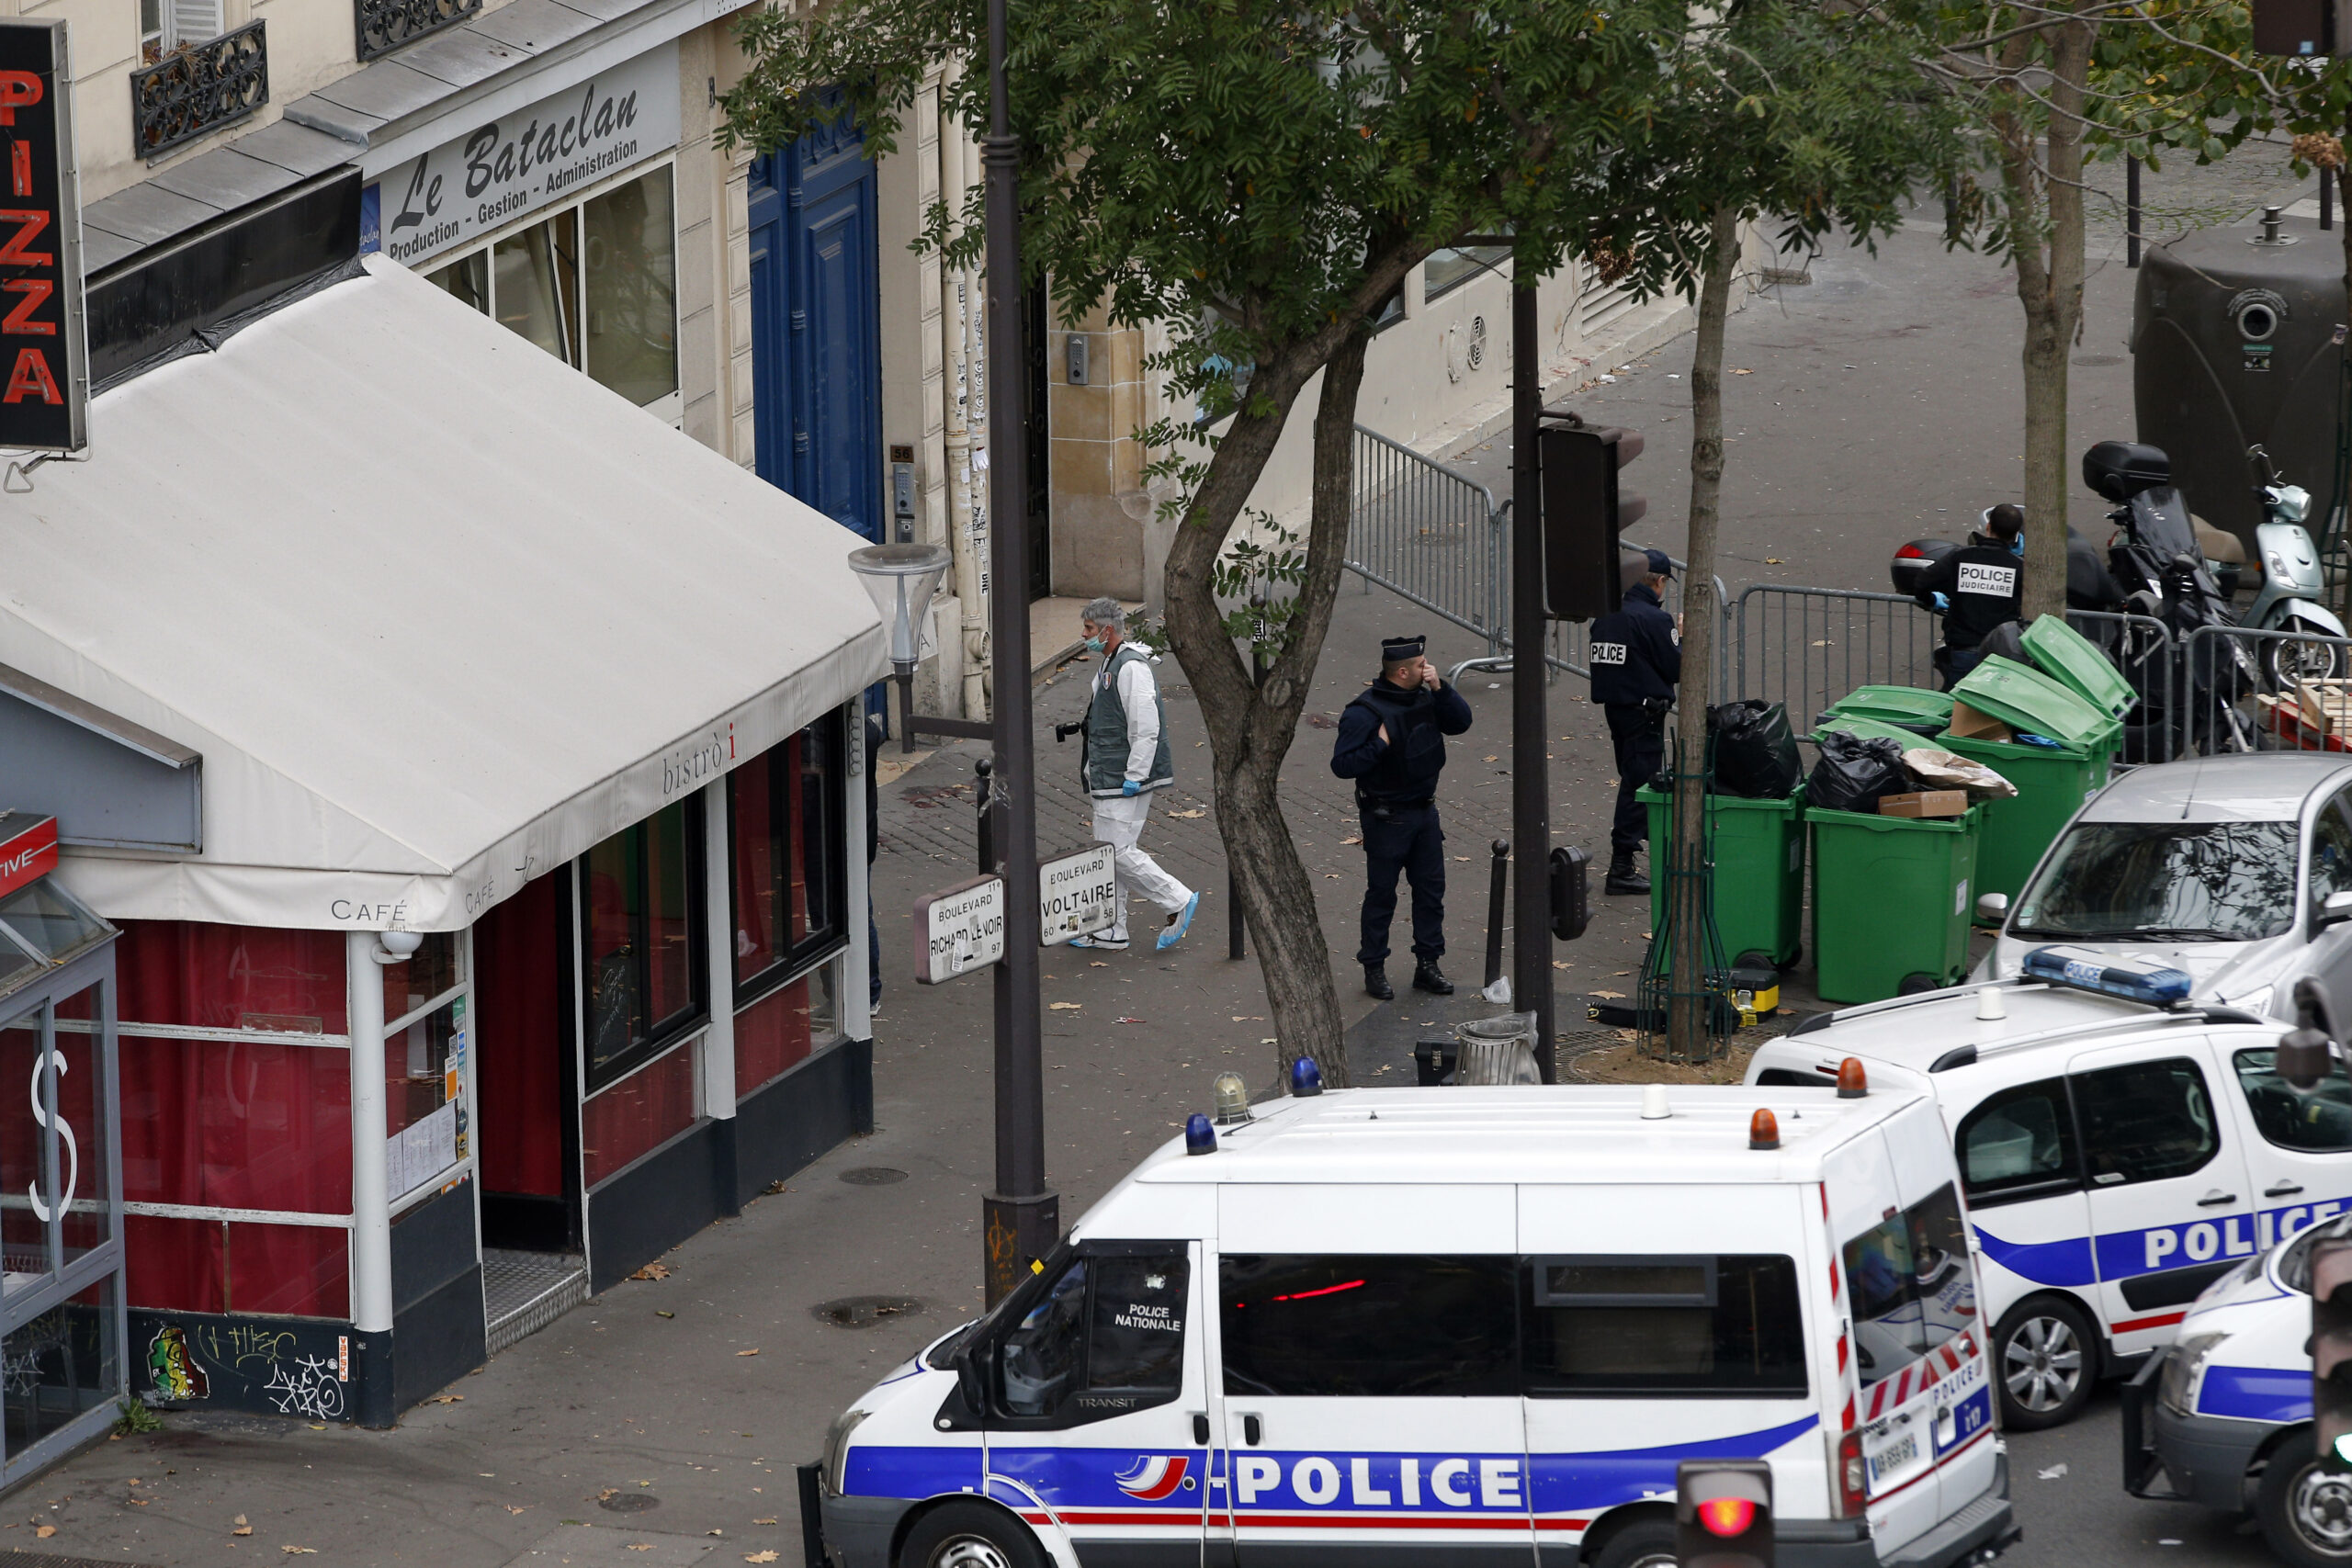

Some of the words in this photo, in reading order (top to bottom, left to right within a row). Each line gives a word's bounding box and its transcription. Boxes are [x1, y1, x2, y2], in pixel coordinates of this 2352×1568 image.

[390, 152, 443, 234] Le
[464, 84, 638, 198] Bataclan
[390, 220, 459, 260] Production
[478, 189, 527, 224] Gestion
[547, 139, 638, 195] Administration
[0, 70, 63, 404] PIZZA
[895, 448, 910, 459] 56
[1961, 567, 2014, 583] POLICE
[1960, 581, 2012, 593] JUDICIAIRE
[1591, 645, 1624, 662] POLICE
[663, 732, 722, 795] bistrò
[0, 848, 33, 878] IVE
[1050, 859, 1104, 885] BOULEVARD
[465, 878, 495, 914] CAFÉ
[1042, 882, 1114, 918] VOLTAIRE
[331, 899, 408, 921] CAFÉ
[938, 894, 993, 922] BOULEVARD
[1103, 908, 1114, 919] 58
[1044, 926, 1055, 938] 60
[991, 942, 1001, 954] 97
[2067, 962, 2102, 982] POLICE
[1128, 1303, 1170, 1318] POLICE
[1114, 1314, 1182, 1332] NATIONALE
[1933, 1365, 1973, 1405] POLICE
[1077, 1397, 1137, 1408] TRANSIT
[1236, 1456, 1523, 1507] POLICE
